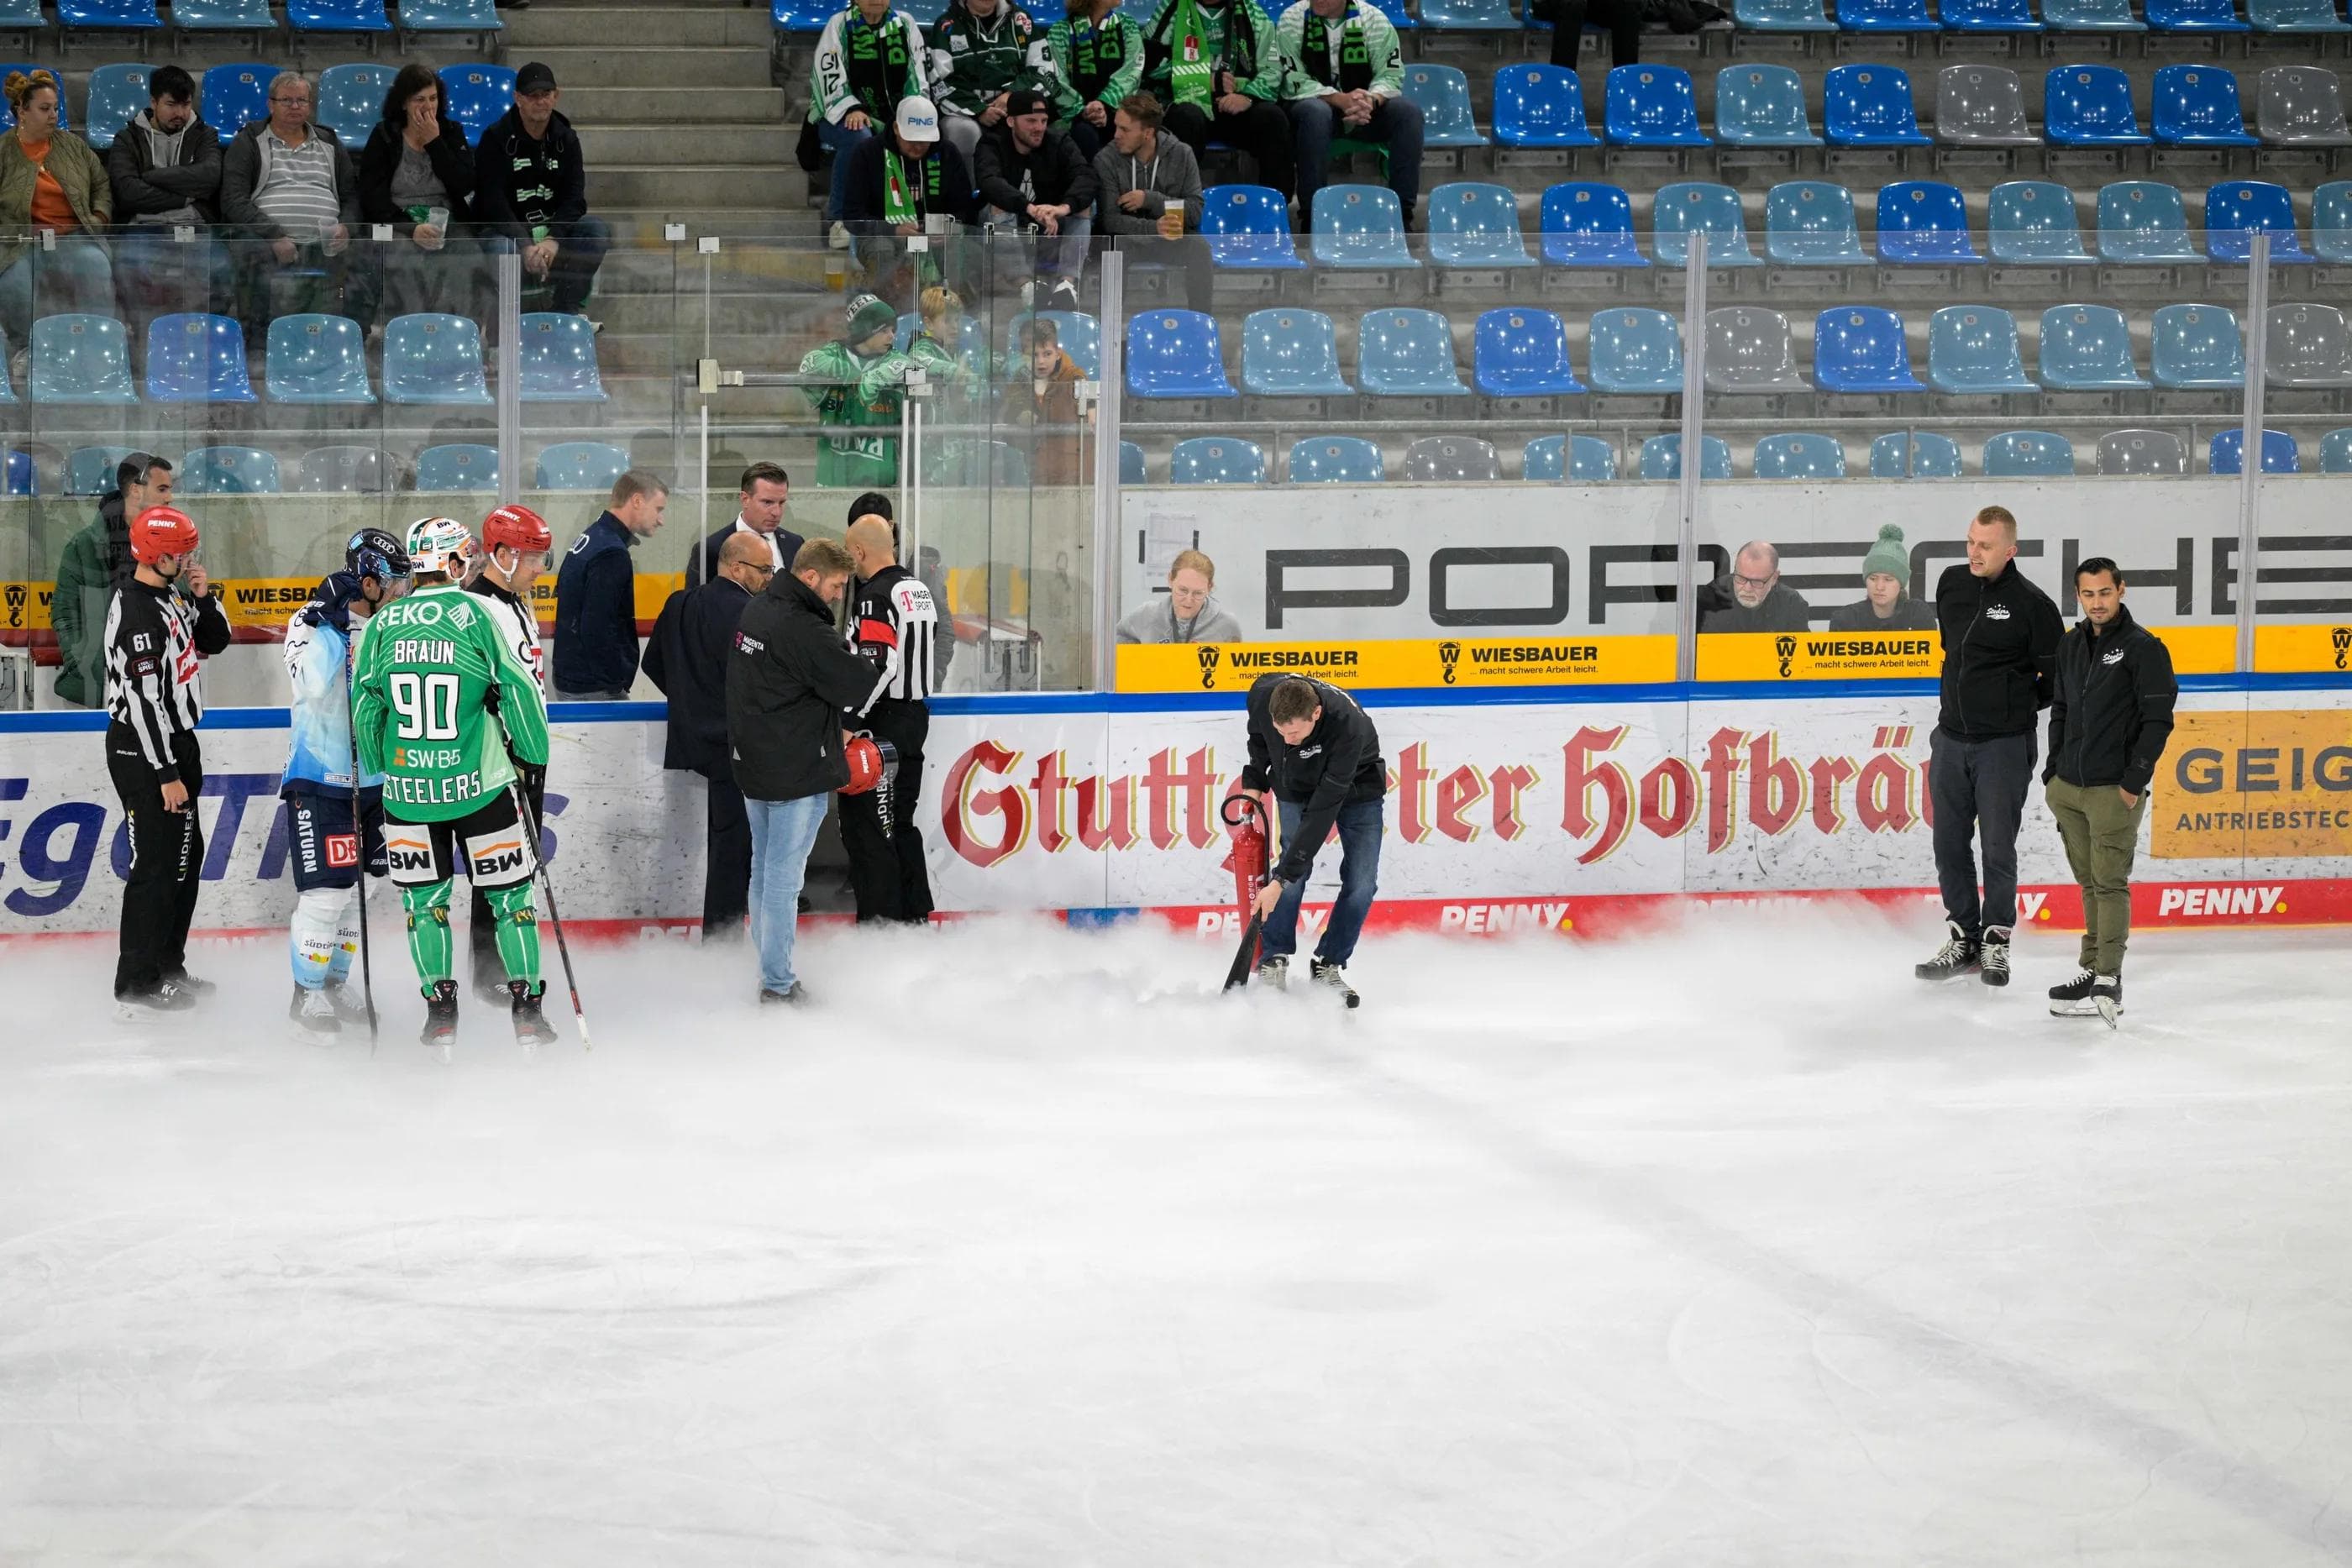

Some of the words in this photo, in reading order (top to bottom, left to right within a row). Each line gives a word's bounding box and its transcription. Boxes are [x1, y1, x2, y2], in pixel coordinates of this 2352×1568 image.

[907, 117, 933, 126] PING
[436, 521, 451, 529] BW
[236, 587, 318, 603] WIESBA
[912, 590, 931, 600] MAGEN
[861, 600, 873, 616] 11
[915, 600, 932, 611] SPORT
[376, 601, 443, 632] REKO
[133, 632, 152, 653] 61
[394, 638, 456, 664] BRAUN
[1807, 640, 1930, 656] WIESBAUER
[1230, 650, 1358, 668] WIESBAUER
[1471, 646, 1598, 663] WIESBAUER
[1814, 660, 1840, 669] macht
[1843, 660, 1877, 669] schwere
[1879, 659, 1904, 668] Arbeit
[1907, 658, 1931, 667] leicht.
[1479, 667, 1506, 675] macht
[1508, 666, 1544, 674] schwere
[1546, 665, 1571, 674] Arbeit
[1573, 664, 1599, 673] leicht.
[389, 671, 460, 742] 90
[2176, 746, 2352, 794] GEIG
[385, 769, 481, 804] STEELERS
[1559, 725, 1939, 865] Hofbrä
[2176, 810, 2350, 831] ANTRIEBSTEC
[177, 810, 196, 882] LINDNER
[297, 809, 318, 873] SATURN
[389, 850, 431, 870] BW
[474, 847, 523, 876] BW
